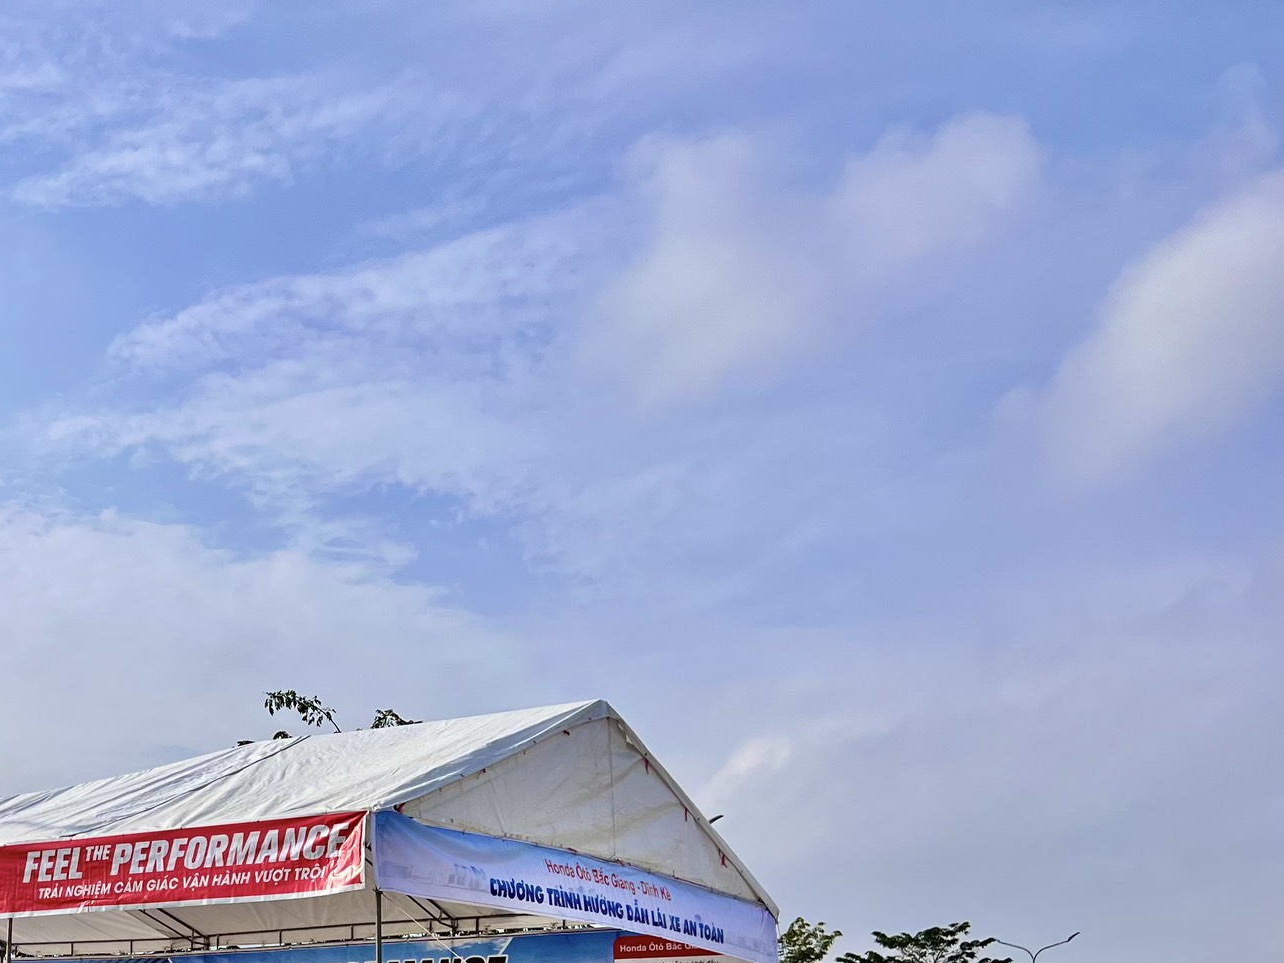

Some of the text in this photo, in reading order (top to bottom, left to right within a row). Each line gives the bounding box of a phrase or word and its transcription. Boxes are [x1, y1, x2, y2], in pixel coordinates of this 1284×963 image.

[23, 822, 350, 883] FEEL THE PERFORMANCE
[39, 863, 326, 899] TRẢI NGHIỆM CẢM GIÁC VẬN HÀNH VƯỢT TRỘI
[545, 858, 575, 878] Honda
[576, 862, 592, 882] Ôtô
[592, 867, 610, 886] Bắc
[610, 873, 636, 895] Giang
[490, 877, 724, 944] CHƯƠNG TRÌNH HƯỚNG DẪN LÁI XE AN TOÀN
[620, 942, 647, 953] Honda
